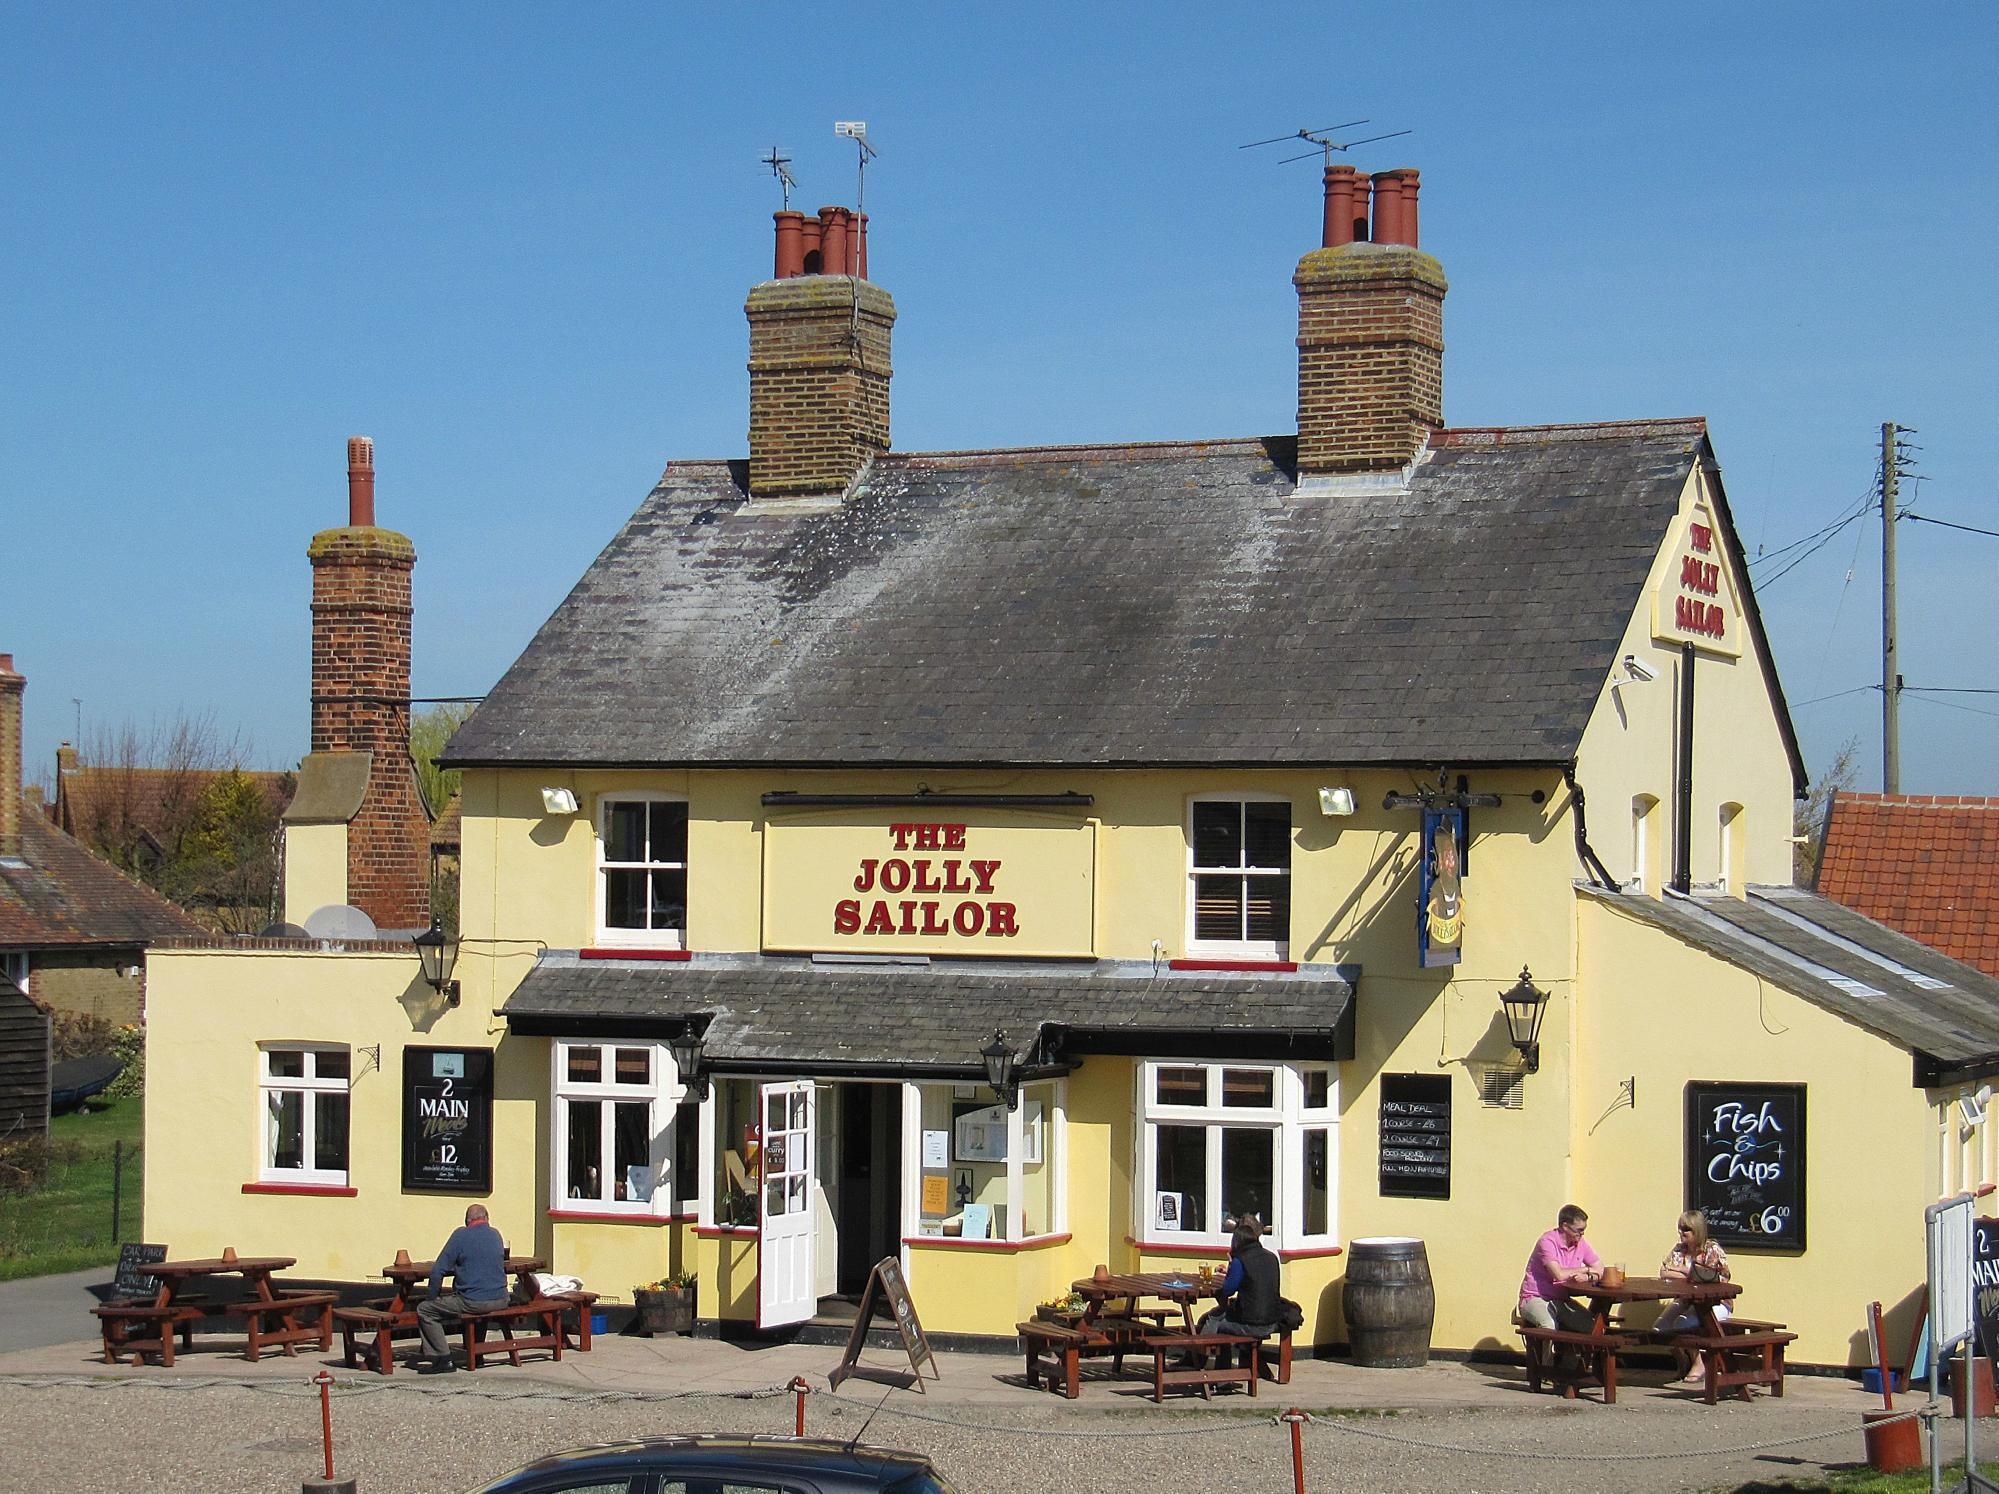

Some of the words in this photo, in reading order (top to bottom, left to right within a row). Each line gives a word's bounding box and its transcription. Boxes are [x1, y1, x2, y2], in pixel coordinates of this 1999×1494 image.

[1690, 522, 1712, 555] THE
[1680, 554, 1720, 598] JOLLY
[1675, 594, 1725, 641] SAILOR
[889, 823, 967, 851] THE
[854, 858, 1001, 894] JOLLY
[834, 899, 1020, 937] SAILOR
[441, 1078, 454, 1097] 2
[420, 1098, 469, 1118] MAIN
[1383, 1102, 1407, 1112] MEAL
[1408, 1104, 1433, 1113] DEAL
[1713, 1101, 1783, 1133] Fish
[1389, 1119, 1414, 1128] COURSE
[767, 1147, 785, 1155] curry
[1391, 1134, 1419, 1144] COURSE
[1734, 1134, 1757, 1152] &
[1382, 1148, 1399, 1157] FOOD
[1707, 1153, 1781, 1186] Chips
[1977, 1228, 1990, 1253] 2
[1972, 1257, 1999, 1288] MAI
